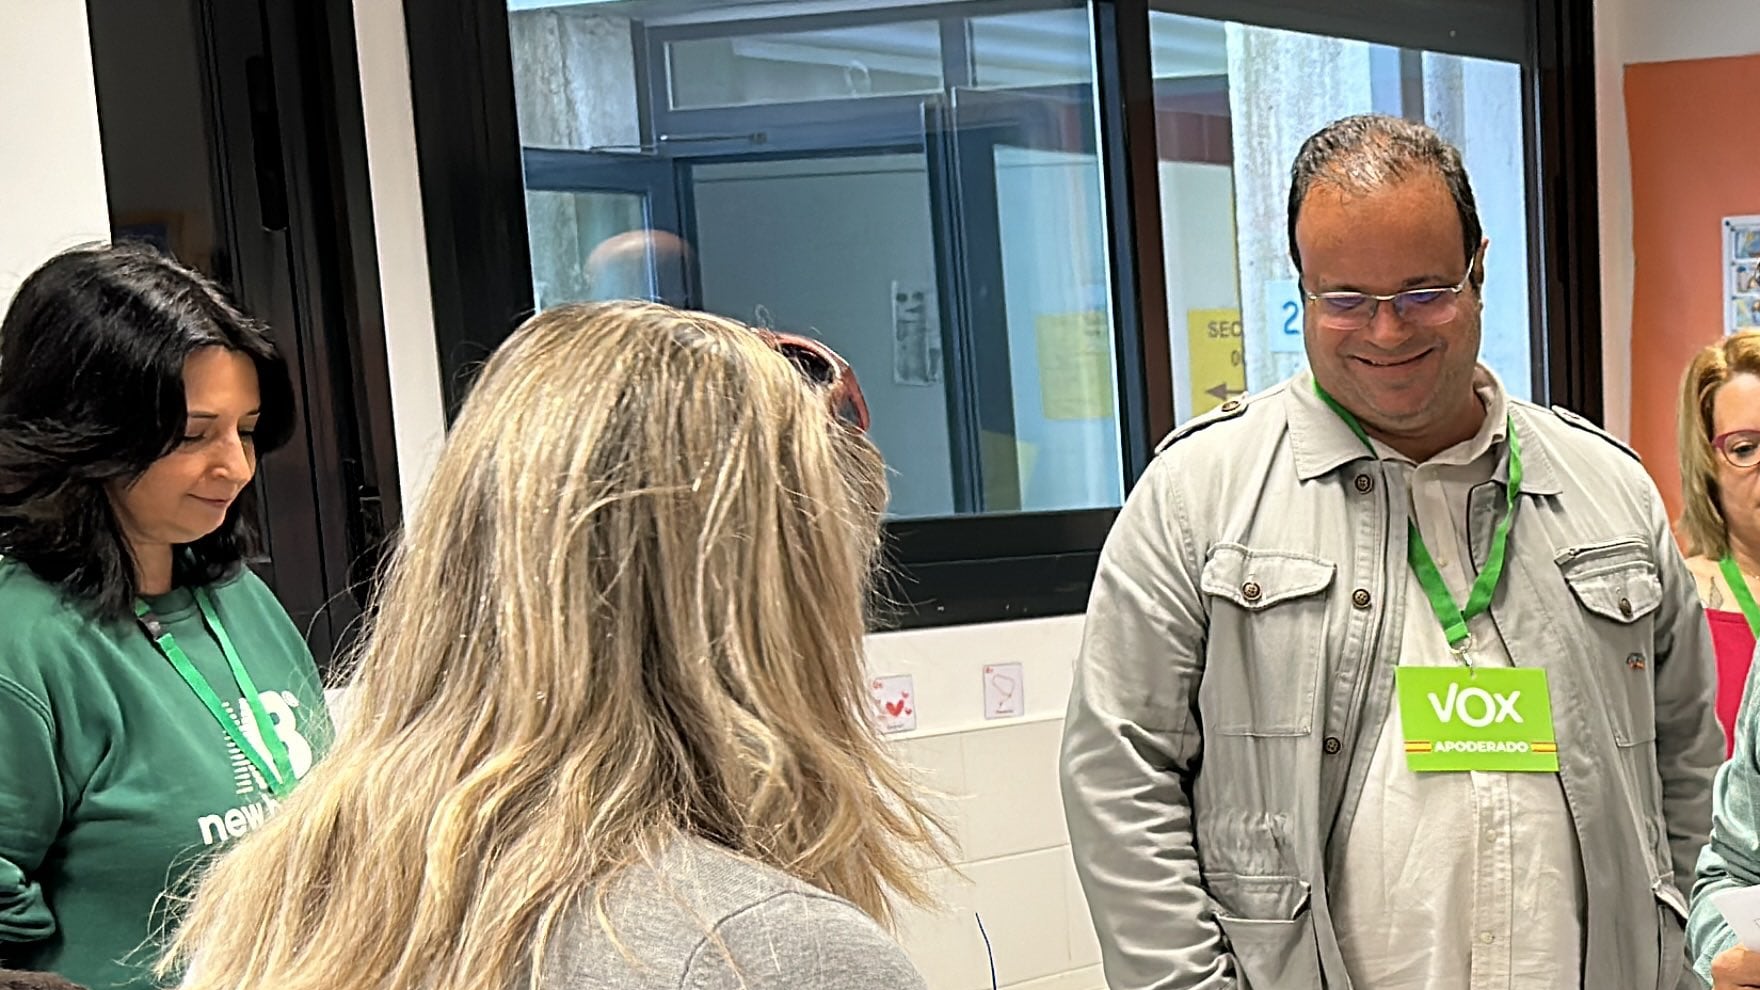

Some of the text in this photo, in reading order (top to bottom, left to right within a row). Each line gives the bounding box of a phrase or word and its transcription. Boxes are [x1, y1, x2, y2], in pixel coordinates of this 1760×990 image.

[1207, 321, 1242, 338] SEC
[1427, 682, 1524, 728] VOX
[1433, 740, 1529, 753] APODERADO
